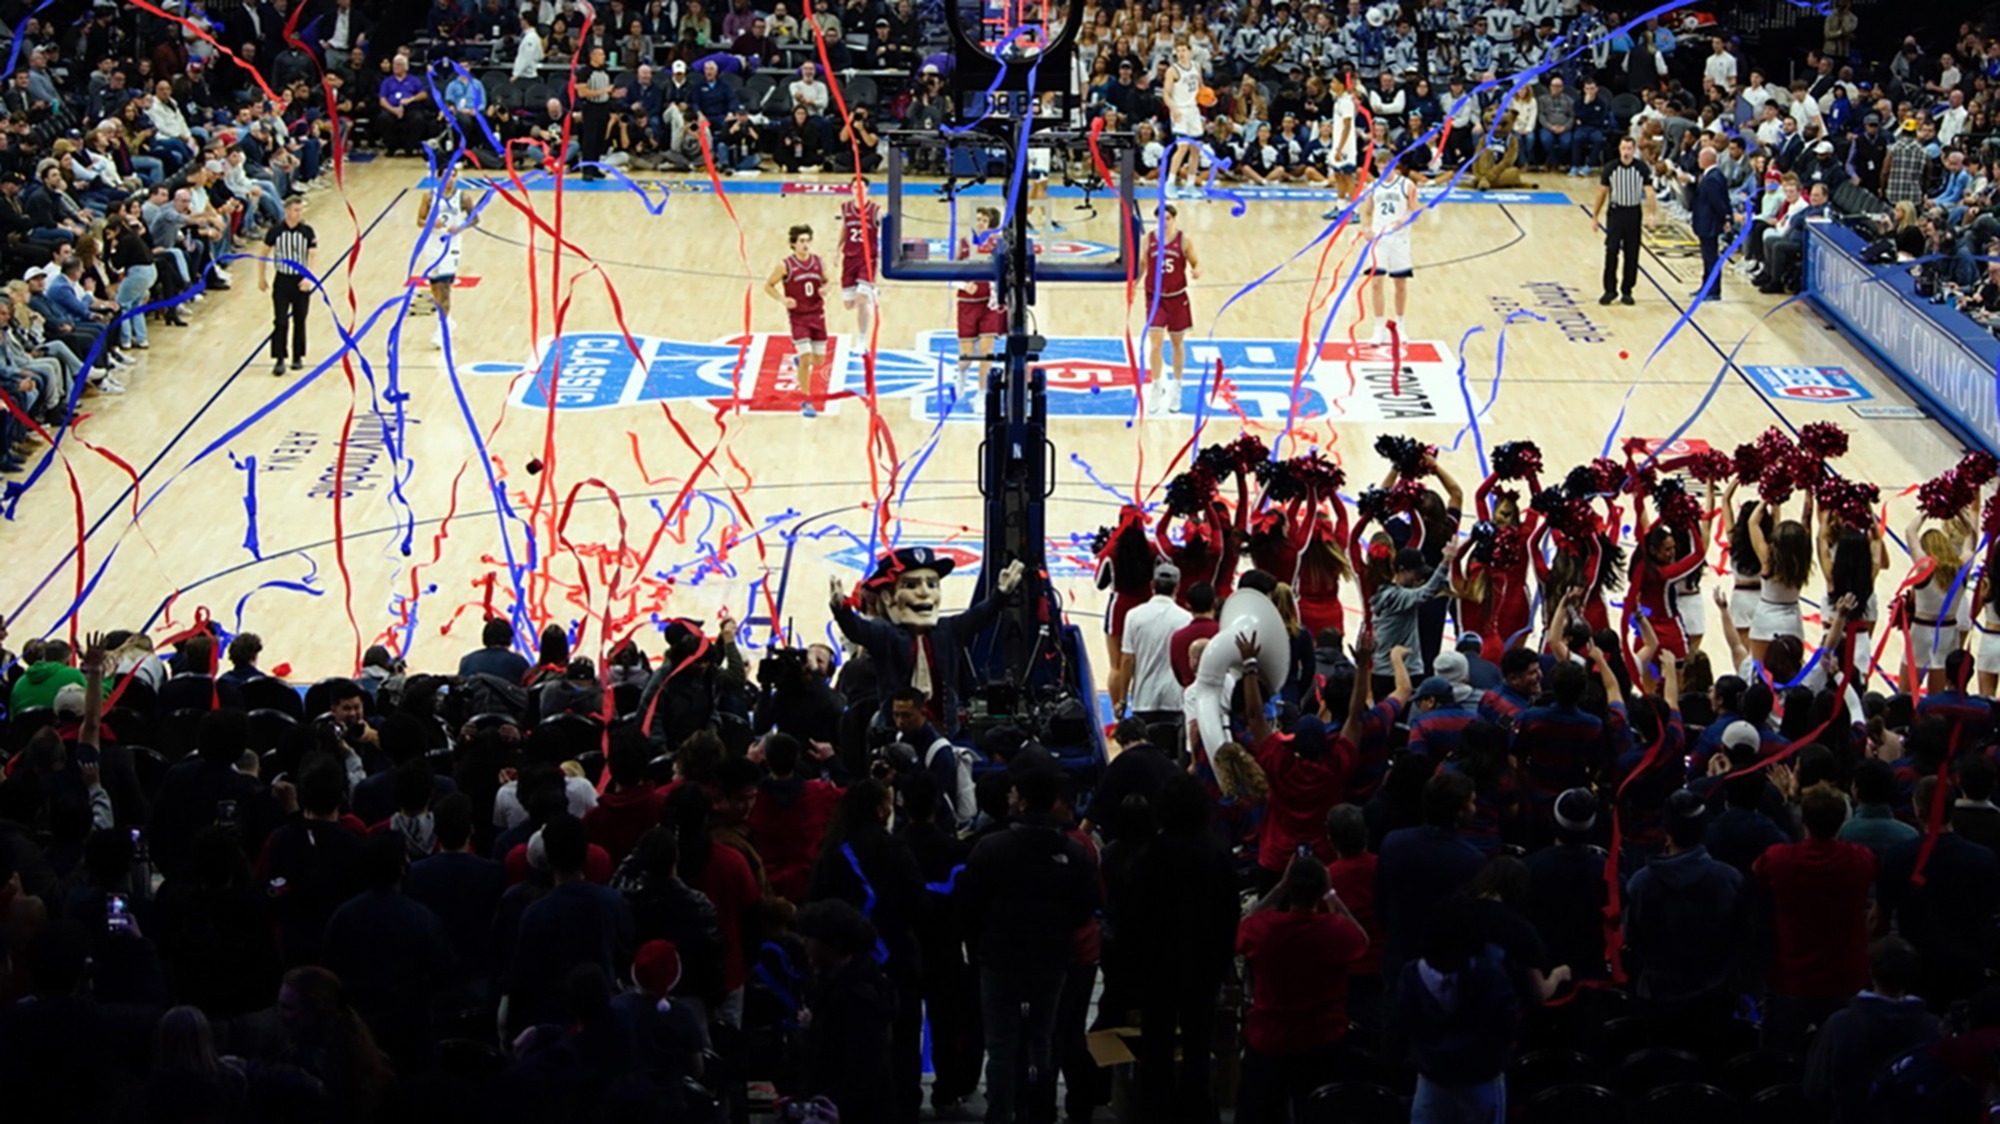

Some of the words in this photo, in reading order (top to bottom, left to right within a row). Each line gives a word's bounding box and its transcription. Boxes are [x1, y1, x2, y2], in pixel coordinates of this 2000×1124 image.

[1492, 17, 1508, 32] V
[1242, 34, 1256, 50] V
[1381, 202, 1395, 216] 24
[804, 281, 814, 297] 0
[1815, 245, 1872, 331] GRUNGO
[1872, 285, 1899, 350] LAW
[1910, 323, 1979, 421] GRUNGO
[556, 337, 613, 404] CLASSIC
[1361, 366, 1437, 419] TOYOTA
[258, 430, 320, 472] ARENA
